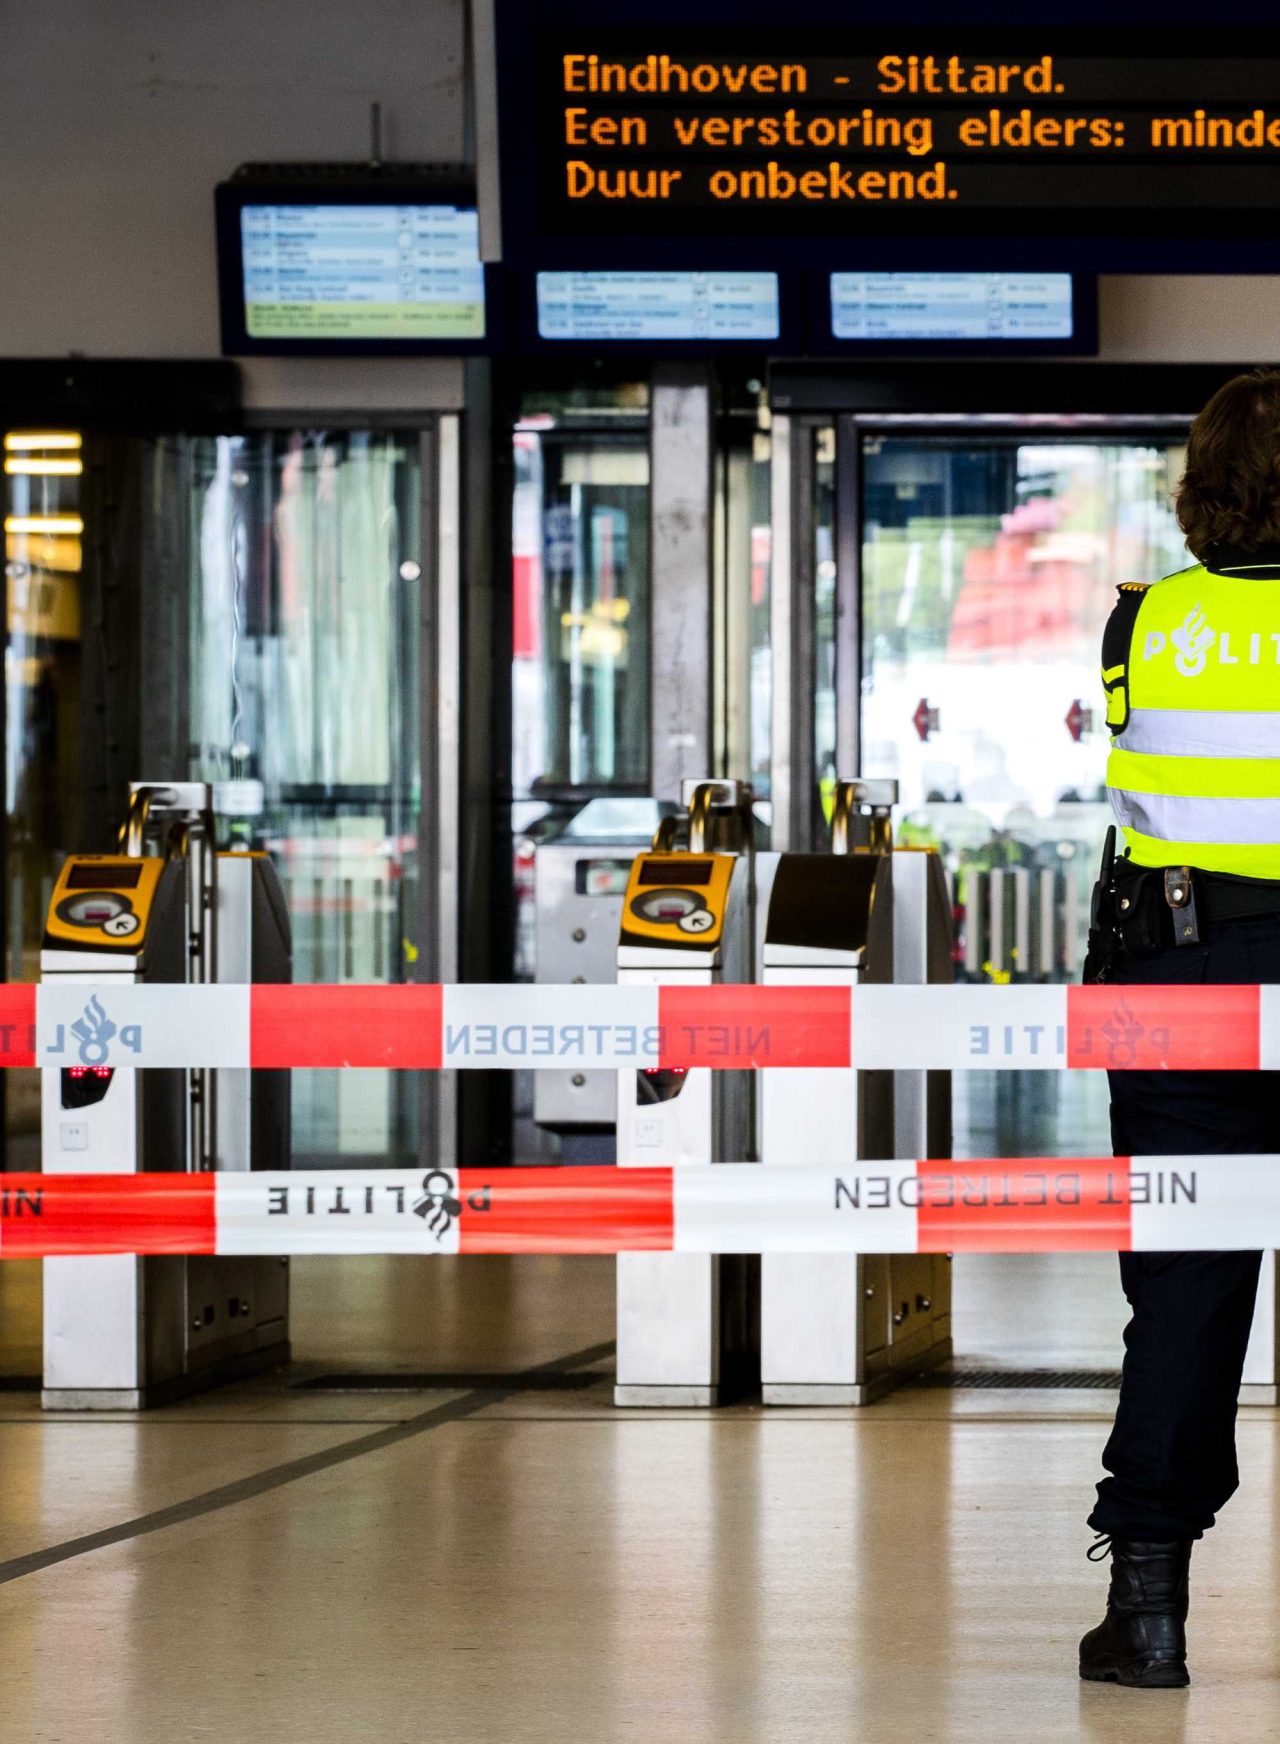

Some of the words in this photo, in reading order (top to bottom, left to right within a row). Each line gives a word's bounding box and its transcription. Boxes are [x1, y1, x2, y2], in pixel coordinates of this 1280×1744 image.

[563, 54, 806, 92] Eindhoven
[878, 55, 1064, 93] Sittard.
[565, 108, 646, 145] Een
[674, 108, 933, 156] verstoring
[959, 109, 1124, 147] elders:
[566, 161, 682, 198] Duur
[710, 161, 959, 199] onbekend.
[834, 1172, 1081, 1210] BETREDEN
[1097, 1171, 1198, 1205] NIET
